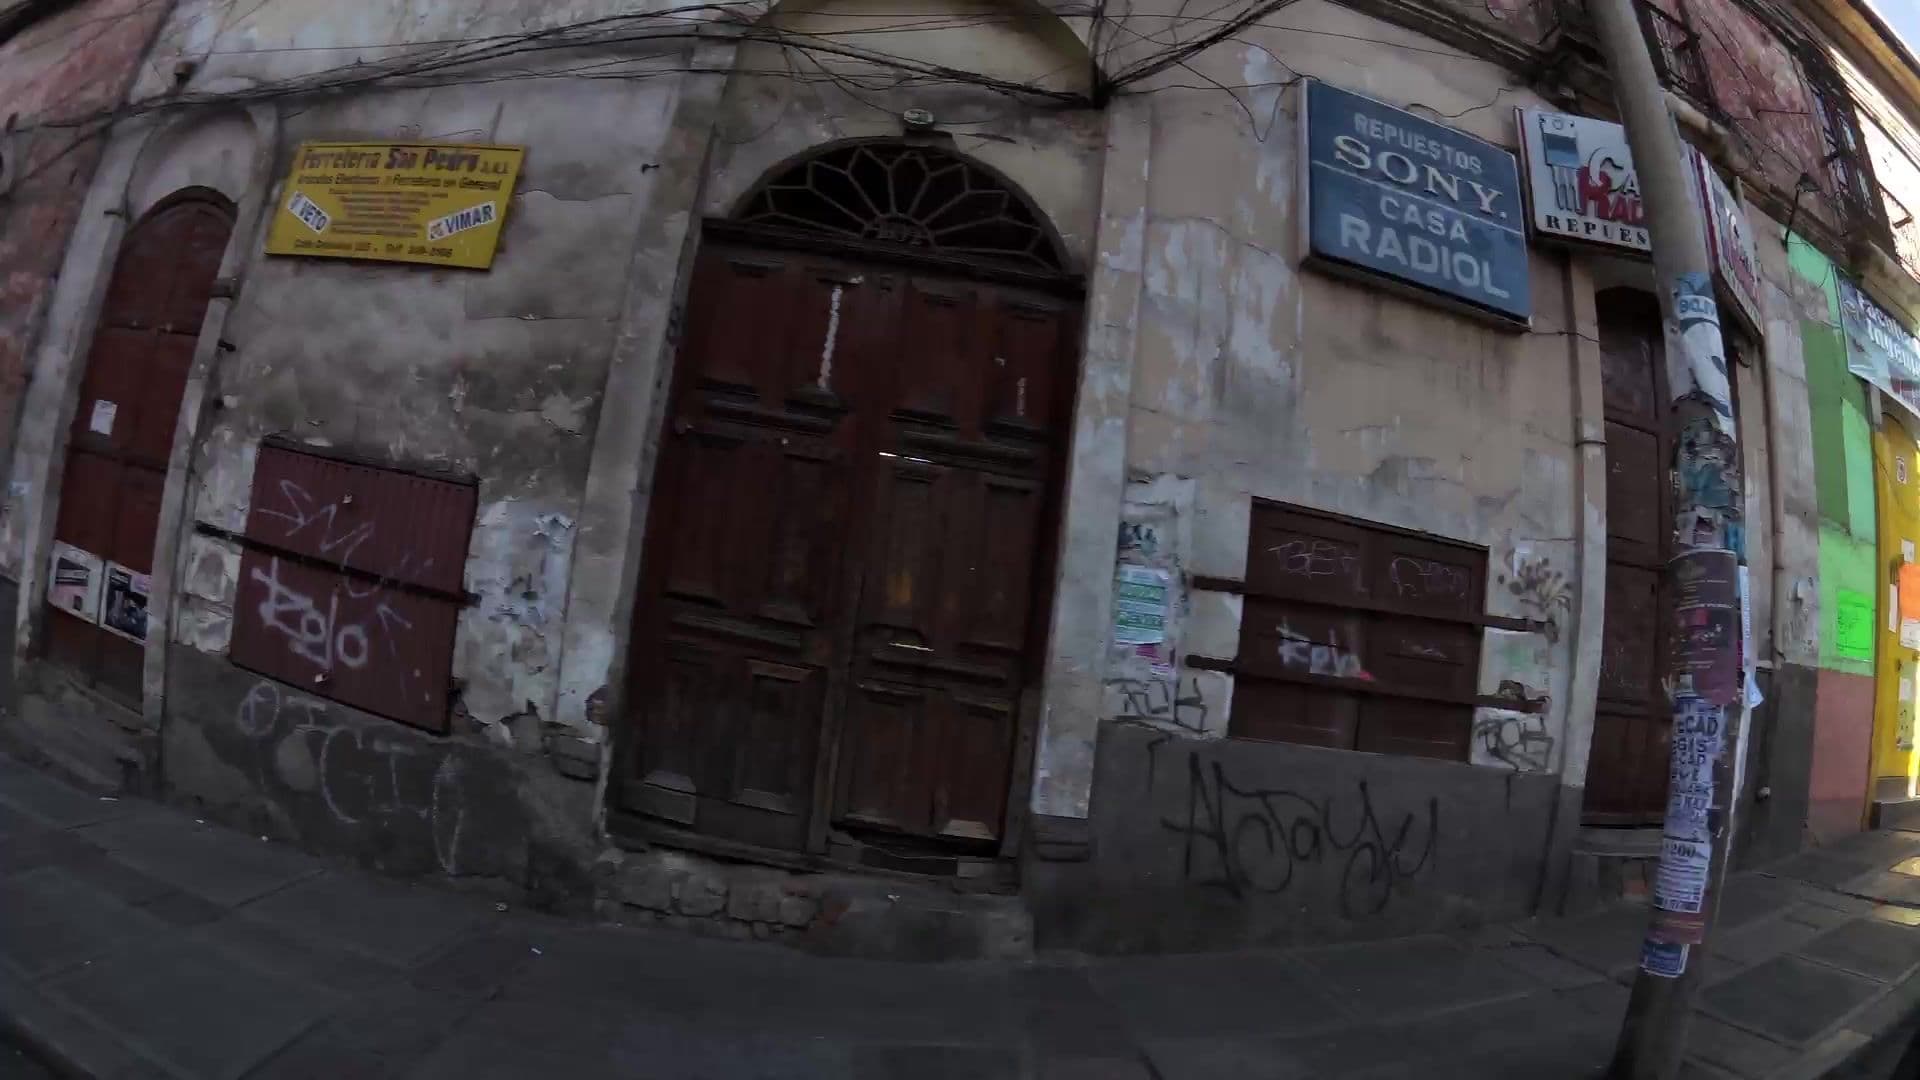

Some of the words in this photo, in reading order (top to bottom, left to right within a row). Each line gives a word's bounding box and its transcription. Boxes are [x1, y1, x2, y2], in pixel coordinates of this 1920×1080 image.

[384, 147, 417, 169] San
[1354, 112, 1482, 175] REPUESTOS
[444, 204, 494, 234] VIMAR
[1379, 195, 1469, 244] CASA
[1339, 212, 1510, 300] RADIOL
